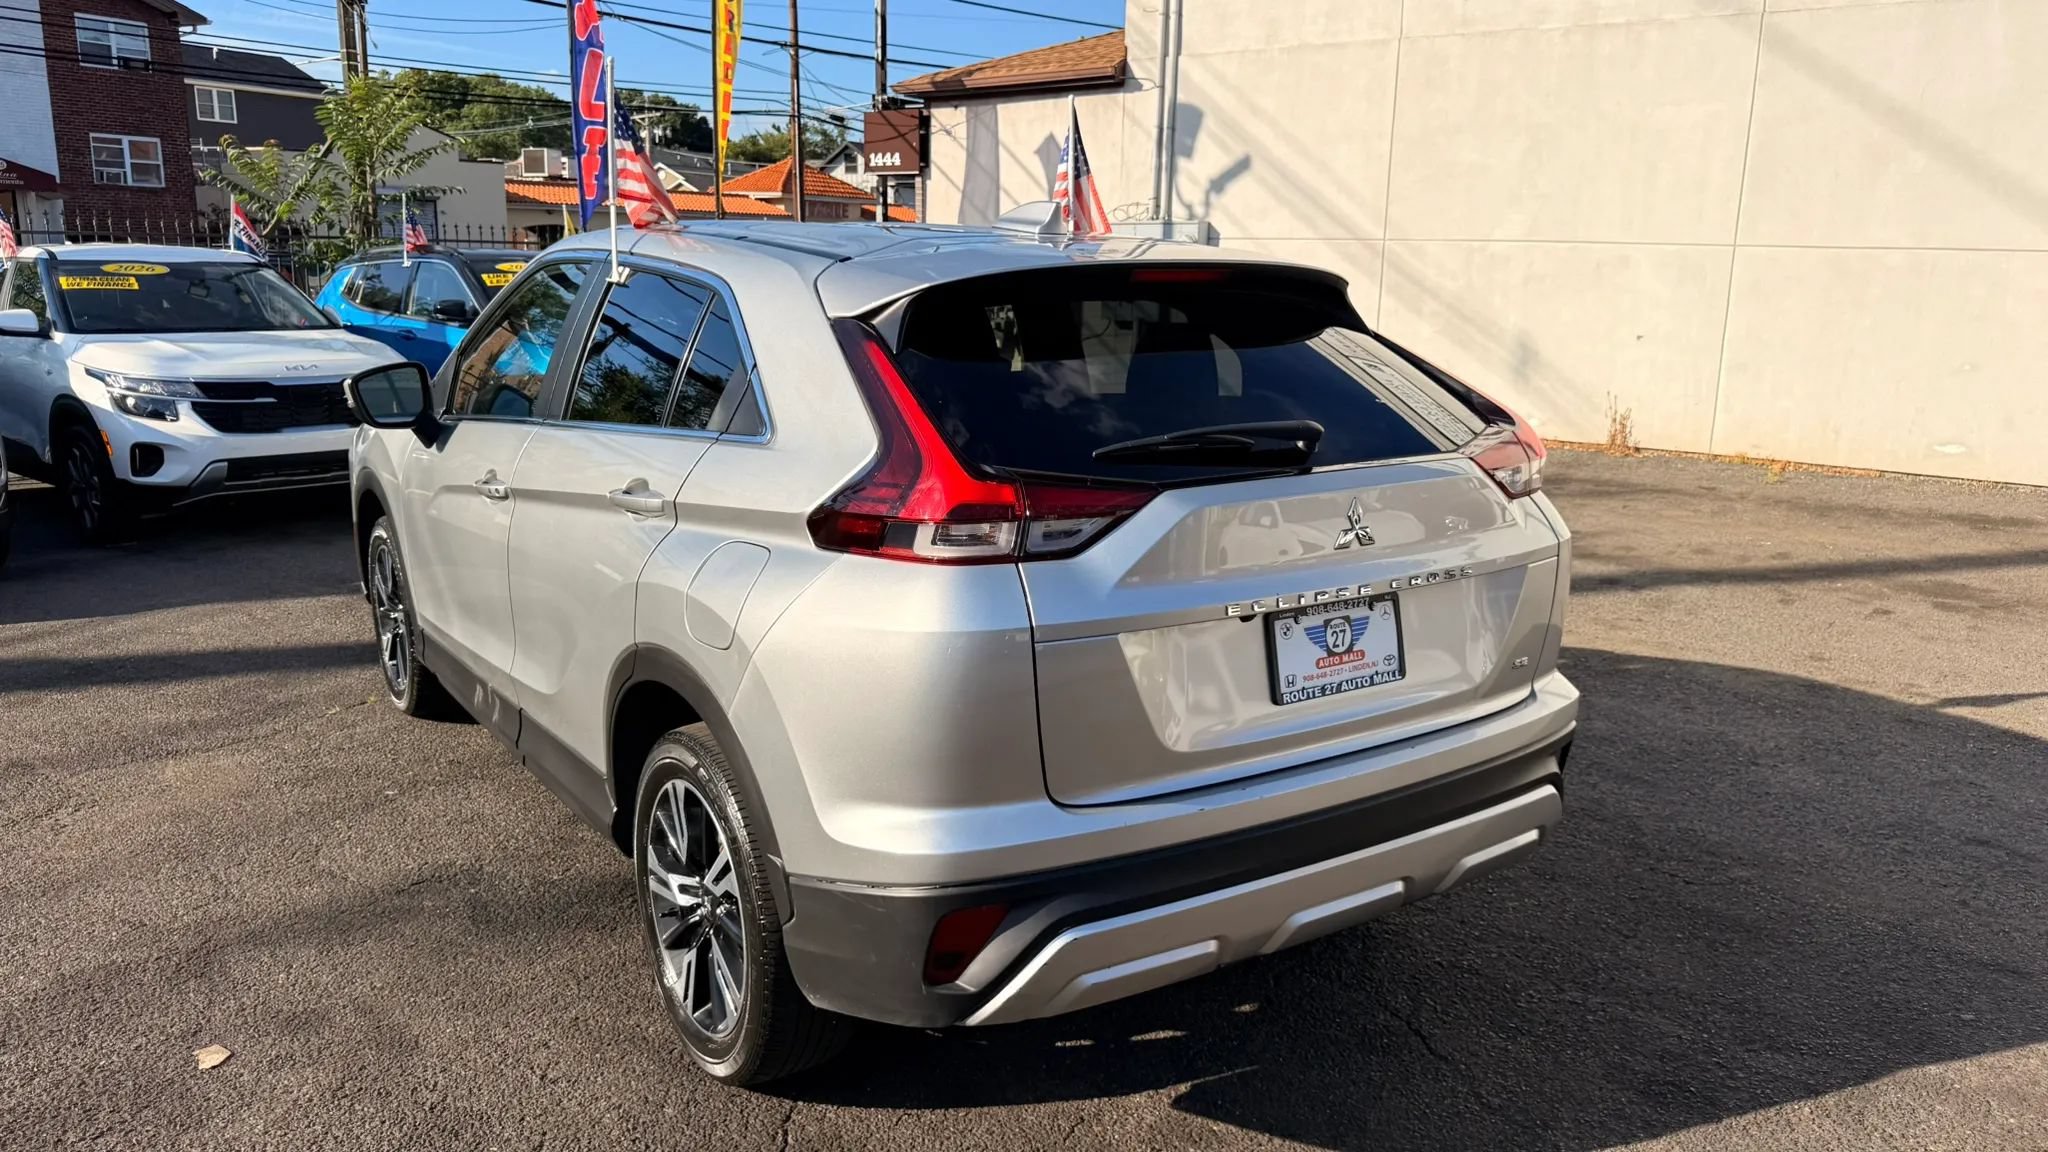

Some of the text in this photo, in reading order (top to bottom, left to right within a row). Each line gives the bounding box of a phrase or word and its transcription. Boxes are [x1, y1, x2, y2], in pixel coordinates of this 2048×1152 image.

[869, 152, 901, 167] 1444
[112, 263, 156, 273] 2026
[1226, 566, 1473, 616] ECLIPSE CROSS
[1306, 597, 1370, 617] 908-648-2727
[1329, 622, 1347, 630] ROUTE
[1331, 629, 1347, 649] 27
[1318, 651, 1363, 668] AUTO MALL
[1302, 668, 1344, 683] 908-648-2727
[1283, 670, 1402, 704] ROUTE 27 AUTO MALL
